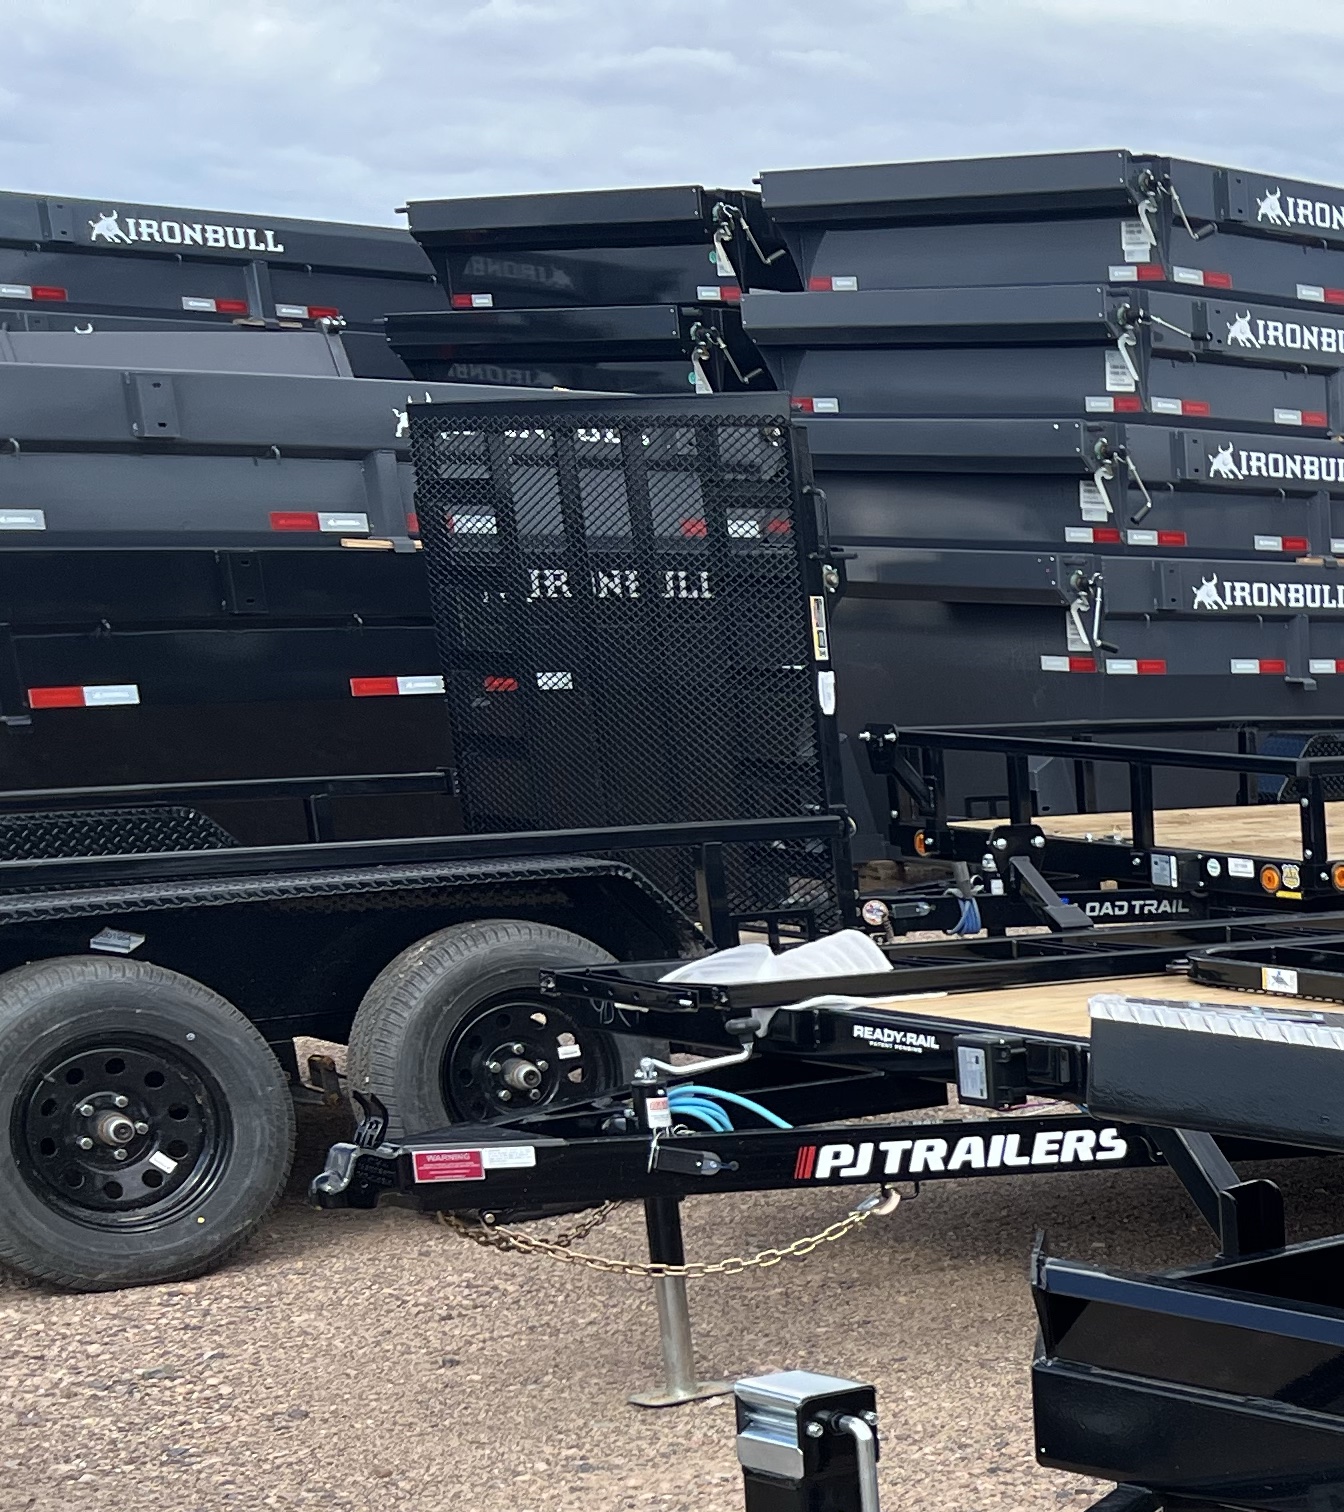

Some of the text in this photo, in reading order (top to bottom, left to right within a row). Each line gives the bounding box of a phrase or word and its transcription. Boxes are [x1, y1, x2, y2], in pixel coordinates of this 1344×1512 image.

[125, 217, 284, 253] IRONBULL
[1085, 900, 1190, 917] OAD TRAIL
